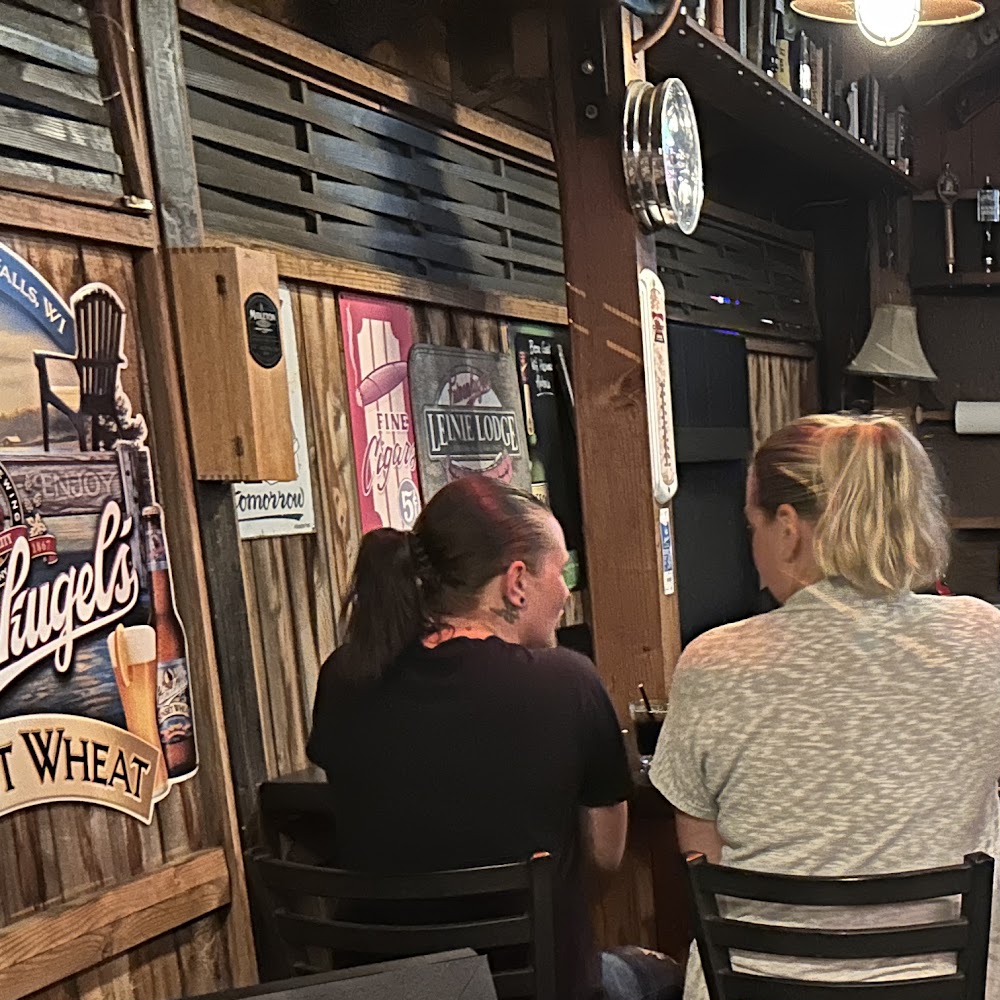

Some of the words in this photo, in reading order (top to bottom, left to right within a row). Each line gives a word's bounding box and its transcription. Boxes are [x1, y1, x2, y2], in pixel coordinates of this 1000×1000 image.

[43, 296, 67, 335] WI
[376, 412, 409, 431] FINE
[427, 413, 475, 451] LEINIE
[475, 413, 519, 451] LODGE
[41, 471, 119, 498] ENJOY
[362, 435, 418, 496] Cigars
[19, 727, 150, 799] WHEAT
